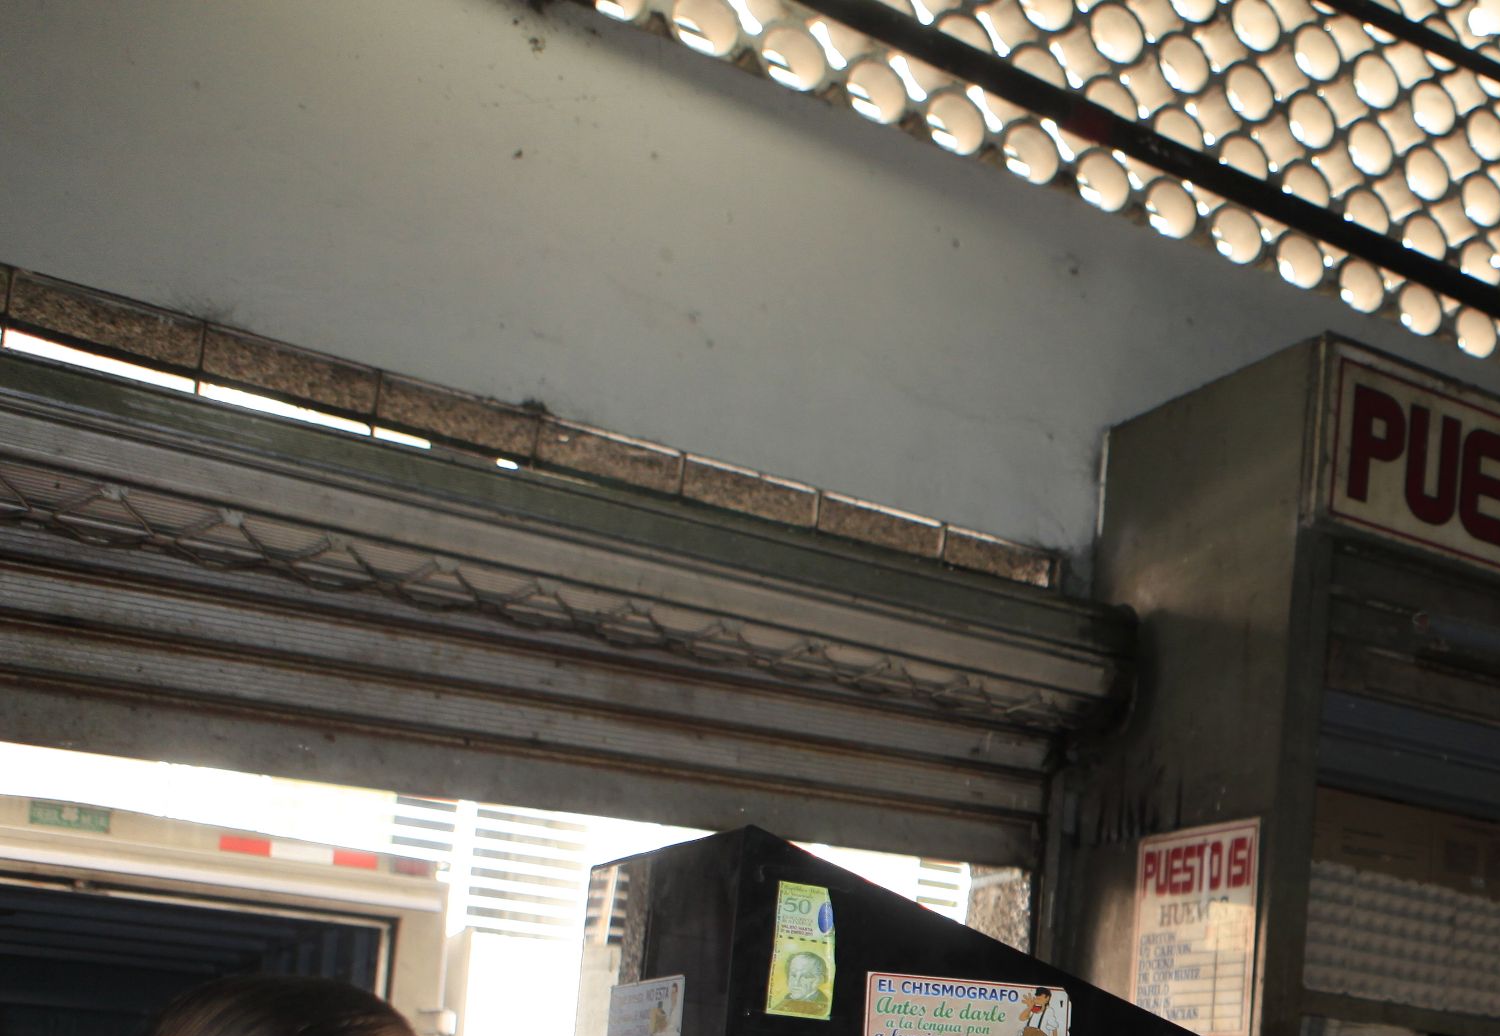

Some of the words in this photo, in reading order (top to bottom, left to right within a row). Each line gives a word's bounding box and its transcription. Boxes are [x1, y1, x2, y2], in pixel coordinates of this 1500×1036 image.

[1143, 839, 1223, 898] PUESTO
[783, 897, 811, 914] 50
[1159, 897, 1229, 927] HUEV
[878, 979, 896, 993] EL
[901, 980, 1019, 1002] CHISMOGRAFO
[876, 996, 926, 1016] Antes
[934, 1000, 951, 1018] de
[959, 1002, 1006, 1023] darle
[899, 1017, 912, 1029] la
[917, 1018, 961, 1034] lengua
[966, 1025, 990, 1036] pon
